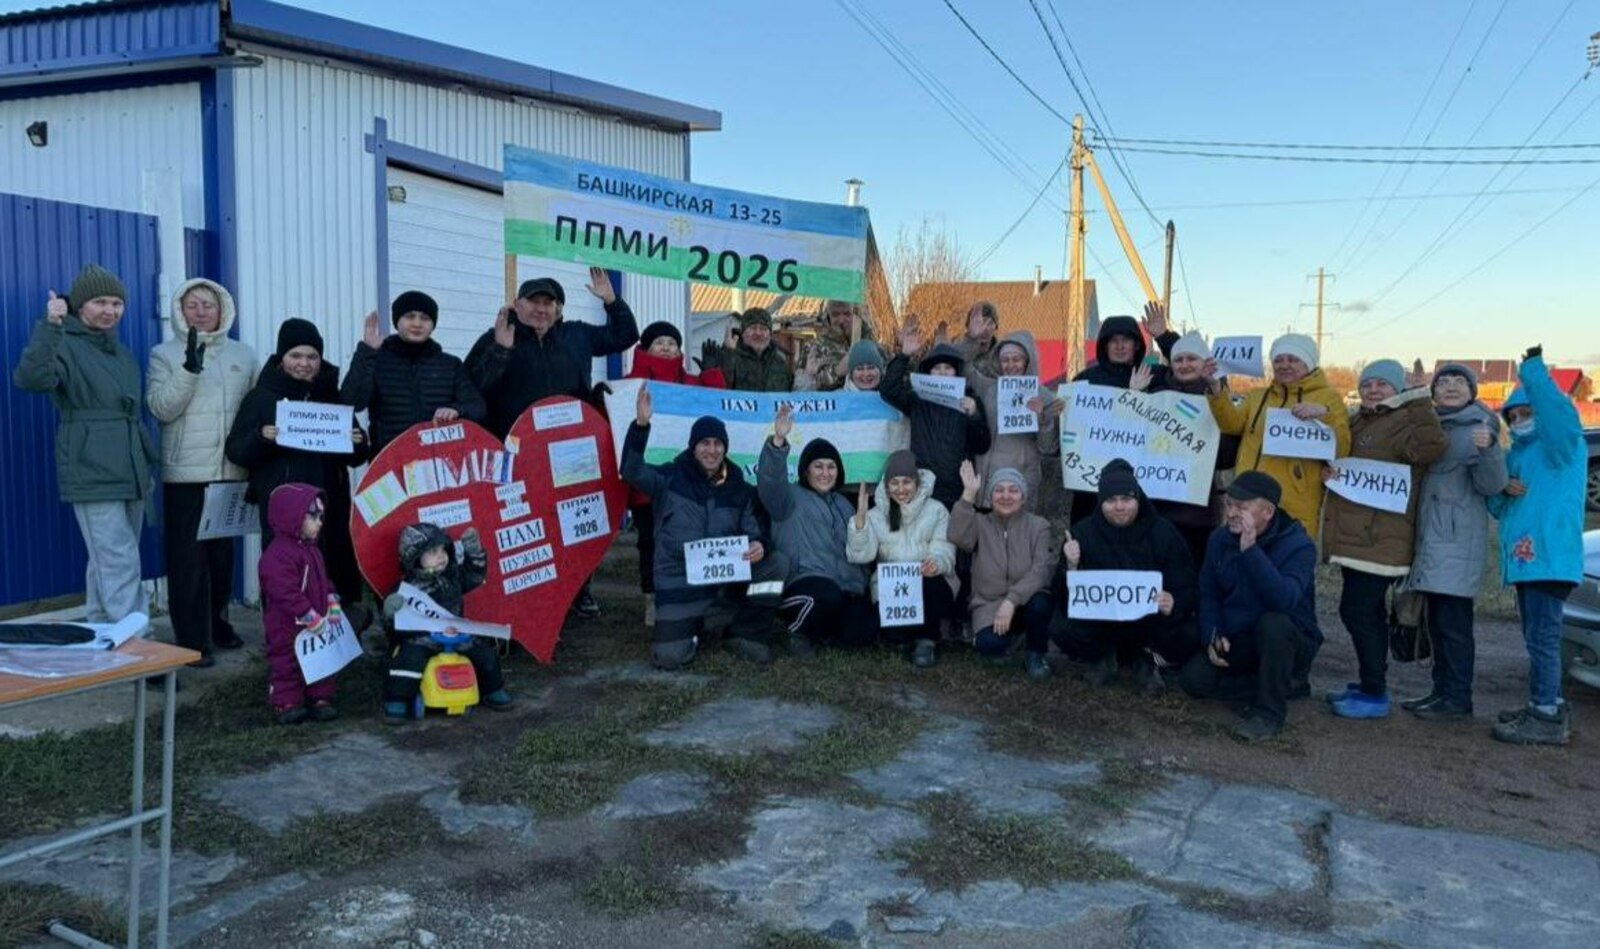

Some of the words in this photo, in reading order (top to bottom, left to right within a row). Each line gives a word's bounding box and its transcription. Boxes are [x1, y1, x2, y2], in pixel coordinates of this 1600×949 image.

[576, 172, 714, 215] БАШКИРСКАЯ
[729, 203, 783, 226] 13-25
[554, 215, 669, 261] ППМИ
[687, 245, 800, 292] 2026
[1213, 346, 1254, 361] НАМ
[1001, 378, 1037, 390] ППМИ
[721, 398, 758, 413] НАМ
[1075, 393, 1114, 412] НАМ
[1003, 413, 1033, 428] 2026
[1117, 391, 1207, 454] БАШКИРСКАЯ
[1088, 426, 1146, 447] НУЖНА
[1135, 465, 1187, 485] ОРОГА
[1336, 467, 1409, 497] НУЖНА
[498, 520, 542, 549] НАМ
[573, 519, 599, 538] 2026
[690, 538, 742, 550] ППМИ
[502, 547, 549, 573] НУЖНА
[506, 567, 552, 592] ДОРОГА
[702, 563, 736, 580] 2026
[882, 565, 921, 579] ППМИ
[1072, 585, 1158, 607] ДОРОГА
[885, 605, 917, 620] 2026
